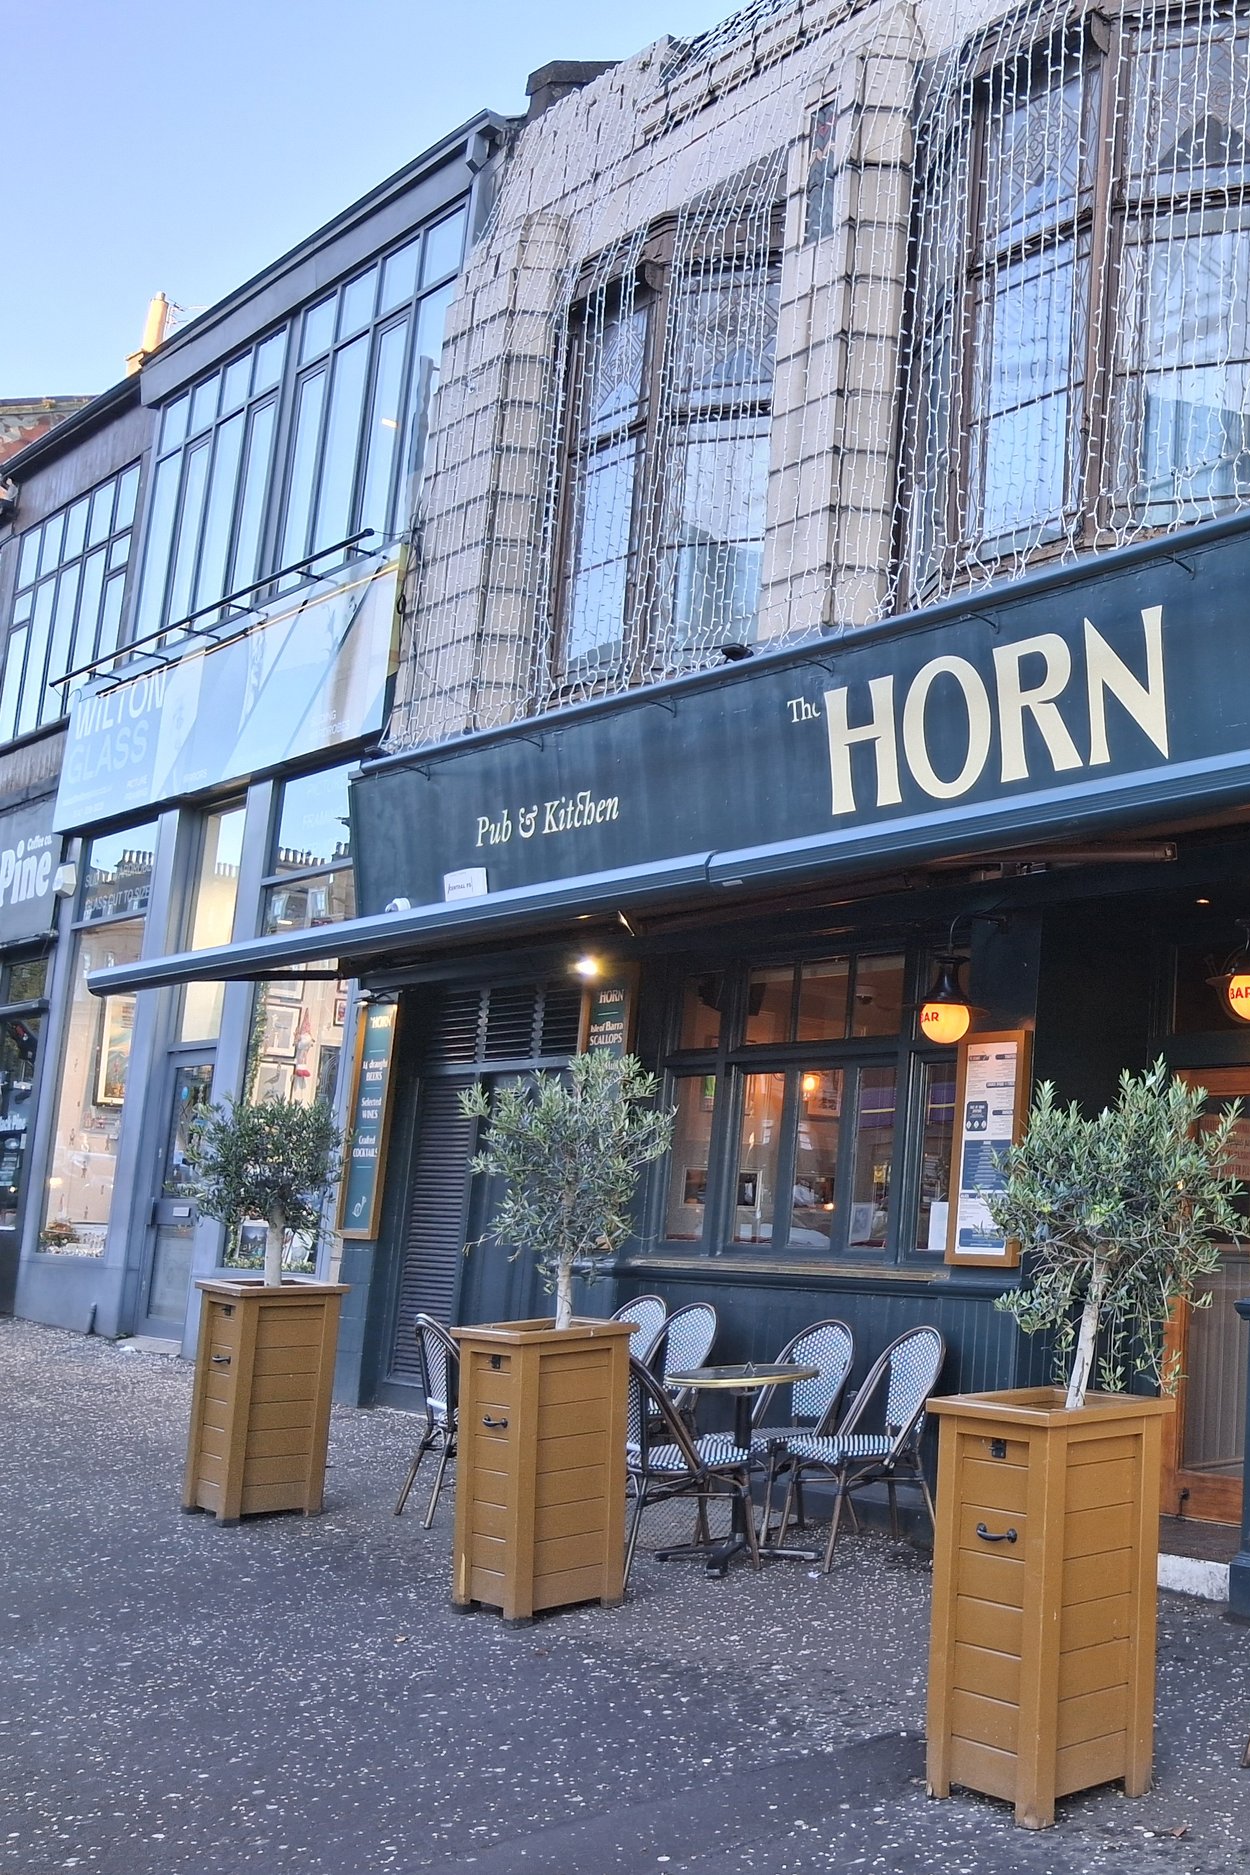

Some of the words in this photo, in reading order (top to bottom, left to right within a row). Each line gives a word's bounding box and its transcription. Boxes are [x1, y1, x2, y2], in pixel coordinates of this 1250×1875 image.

[75, 669, 167, 740] WILTON
[787, 696, 821, 723] The
[823, 605, 1170, 816] HORN
[67, 720, 150, 785] GLASS
[476, 808, 512, 847] Pub
[519, 805, 538, 838] &
[542, 790, 619, 834] Kitchen
[605, 1021, 624, 1031] Barra
[590, 1033, 623, 1046] SCALLOPS
[361, 1097, 382, 1107] Selected
[362, 1109, 378, 1119] WINES
[358, 1135, 376, 1145] Crafted
